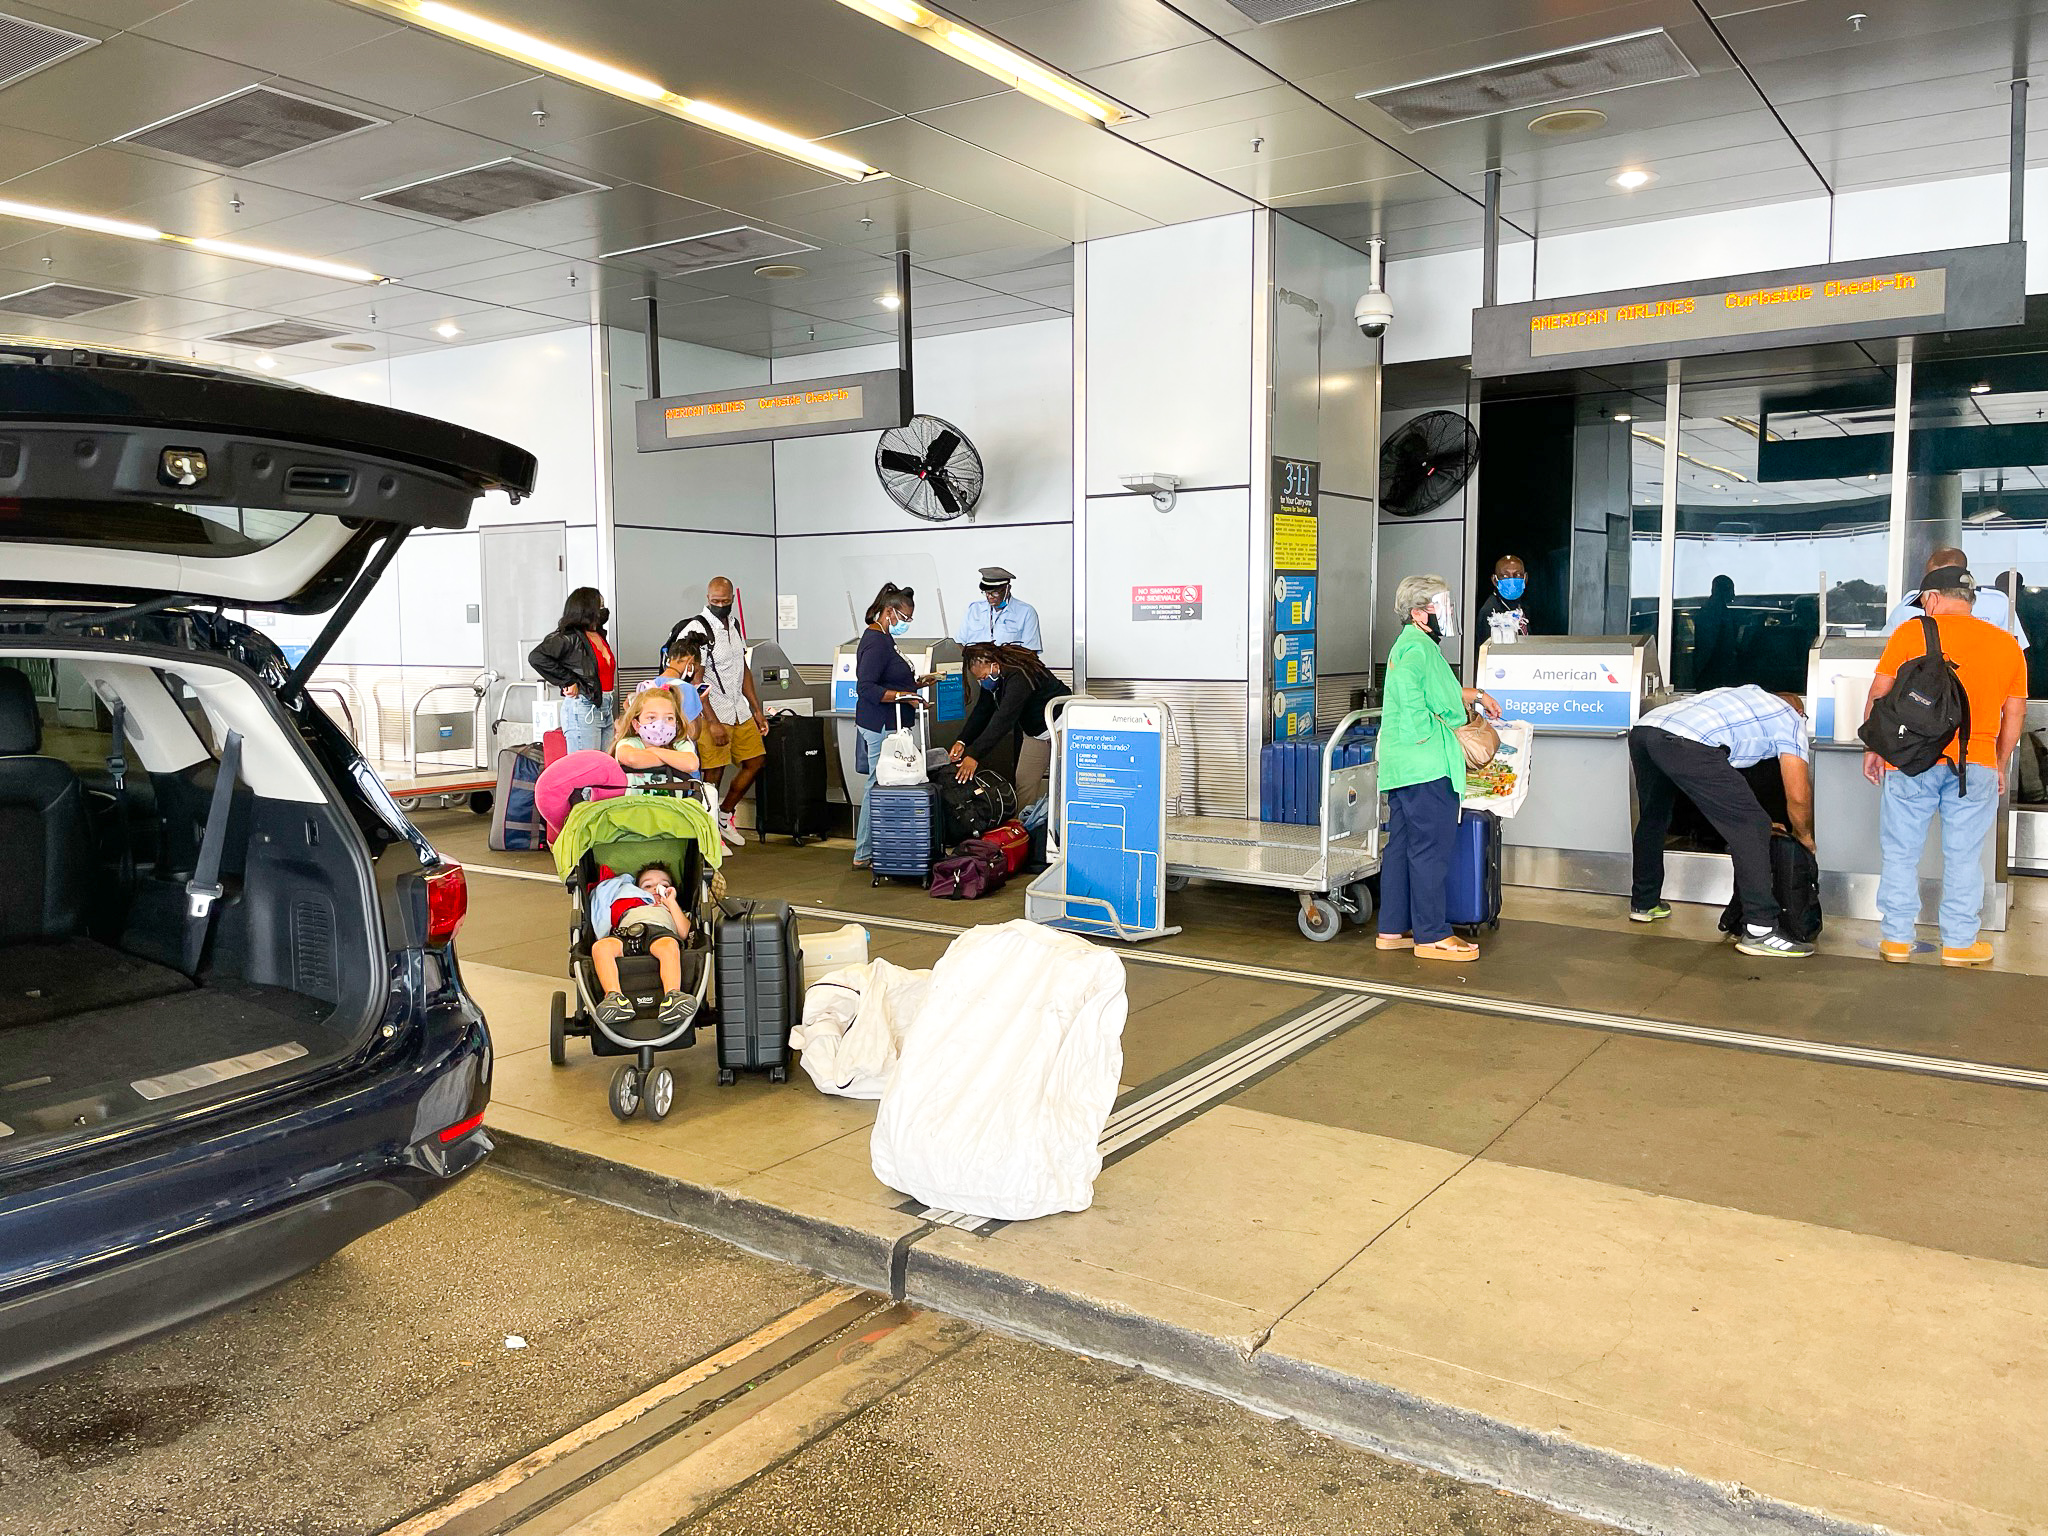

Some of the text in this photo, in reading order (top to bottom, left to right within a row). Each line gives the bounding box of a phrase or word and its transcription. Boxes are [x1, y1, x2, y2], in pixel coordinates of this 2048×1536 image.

[1531, 273, 1916, 332] AMERICAN AIRLINES Curbside Check-In
[665, 388, 849, 419] AMERICAN AIRLINES Curbside Check-In
[1532, 668, 1597, 681] American
[1505, 698, 1604, 715] Baggage Check
[1112, 715, 1143, 724] American
[1072, 733, 1093, 742] Carry-on
[1101, 743, 1130, 751] facturado?
